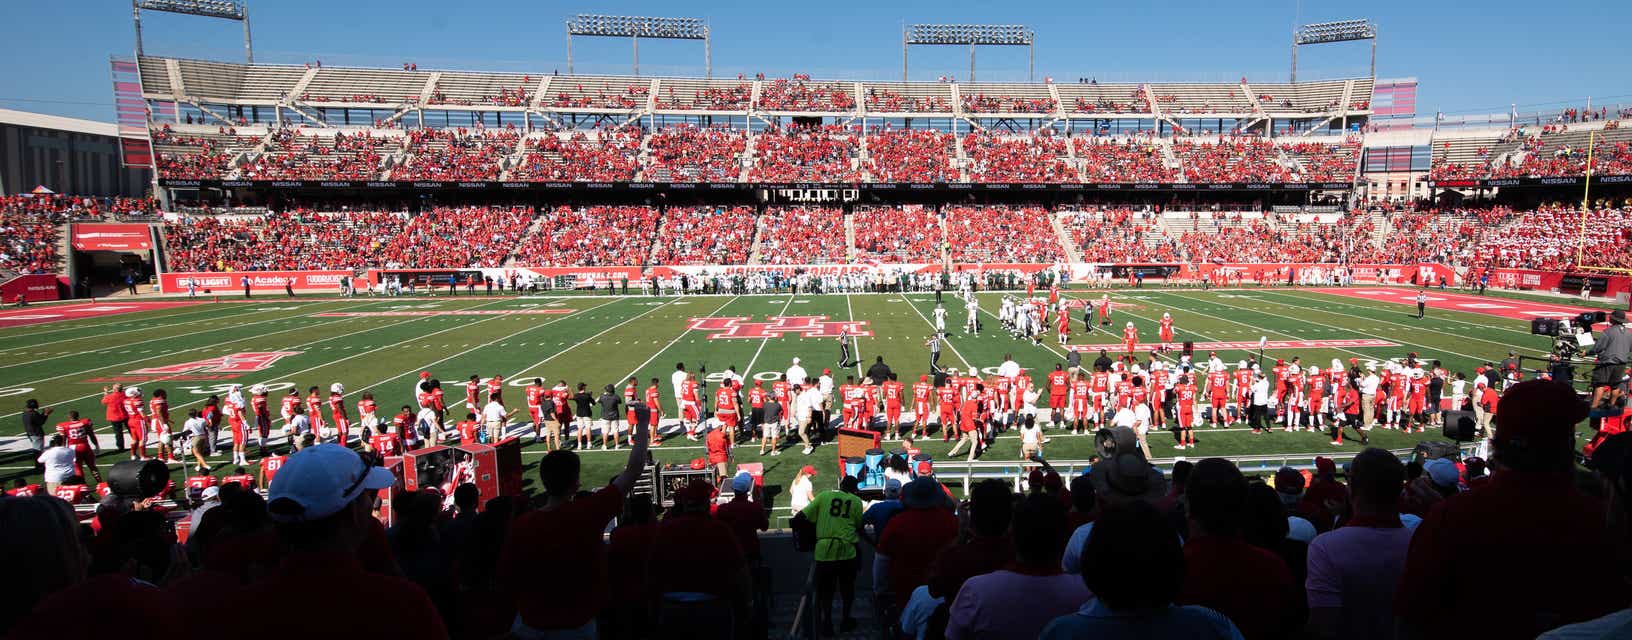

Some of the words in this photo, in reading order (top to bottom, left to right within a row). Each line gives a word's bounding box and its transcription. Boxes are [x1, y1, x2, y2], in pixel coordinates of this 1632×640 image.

[1054, 376, 1064, 385] 56
[1097, 377, 1107, 387] 87
[1214, 377, 1225, 387] 90
[887, 389, 896, 399] 51
[380, 441, 393, 454] 14
[268, 460, 281, 471] 81
[829, 498, 852, 519] 81
